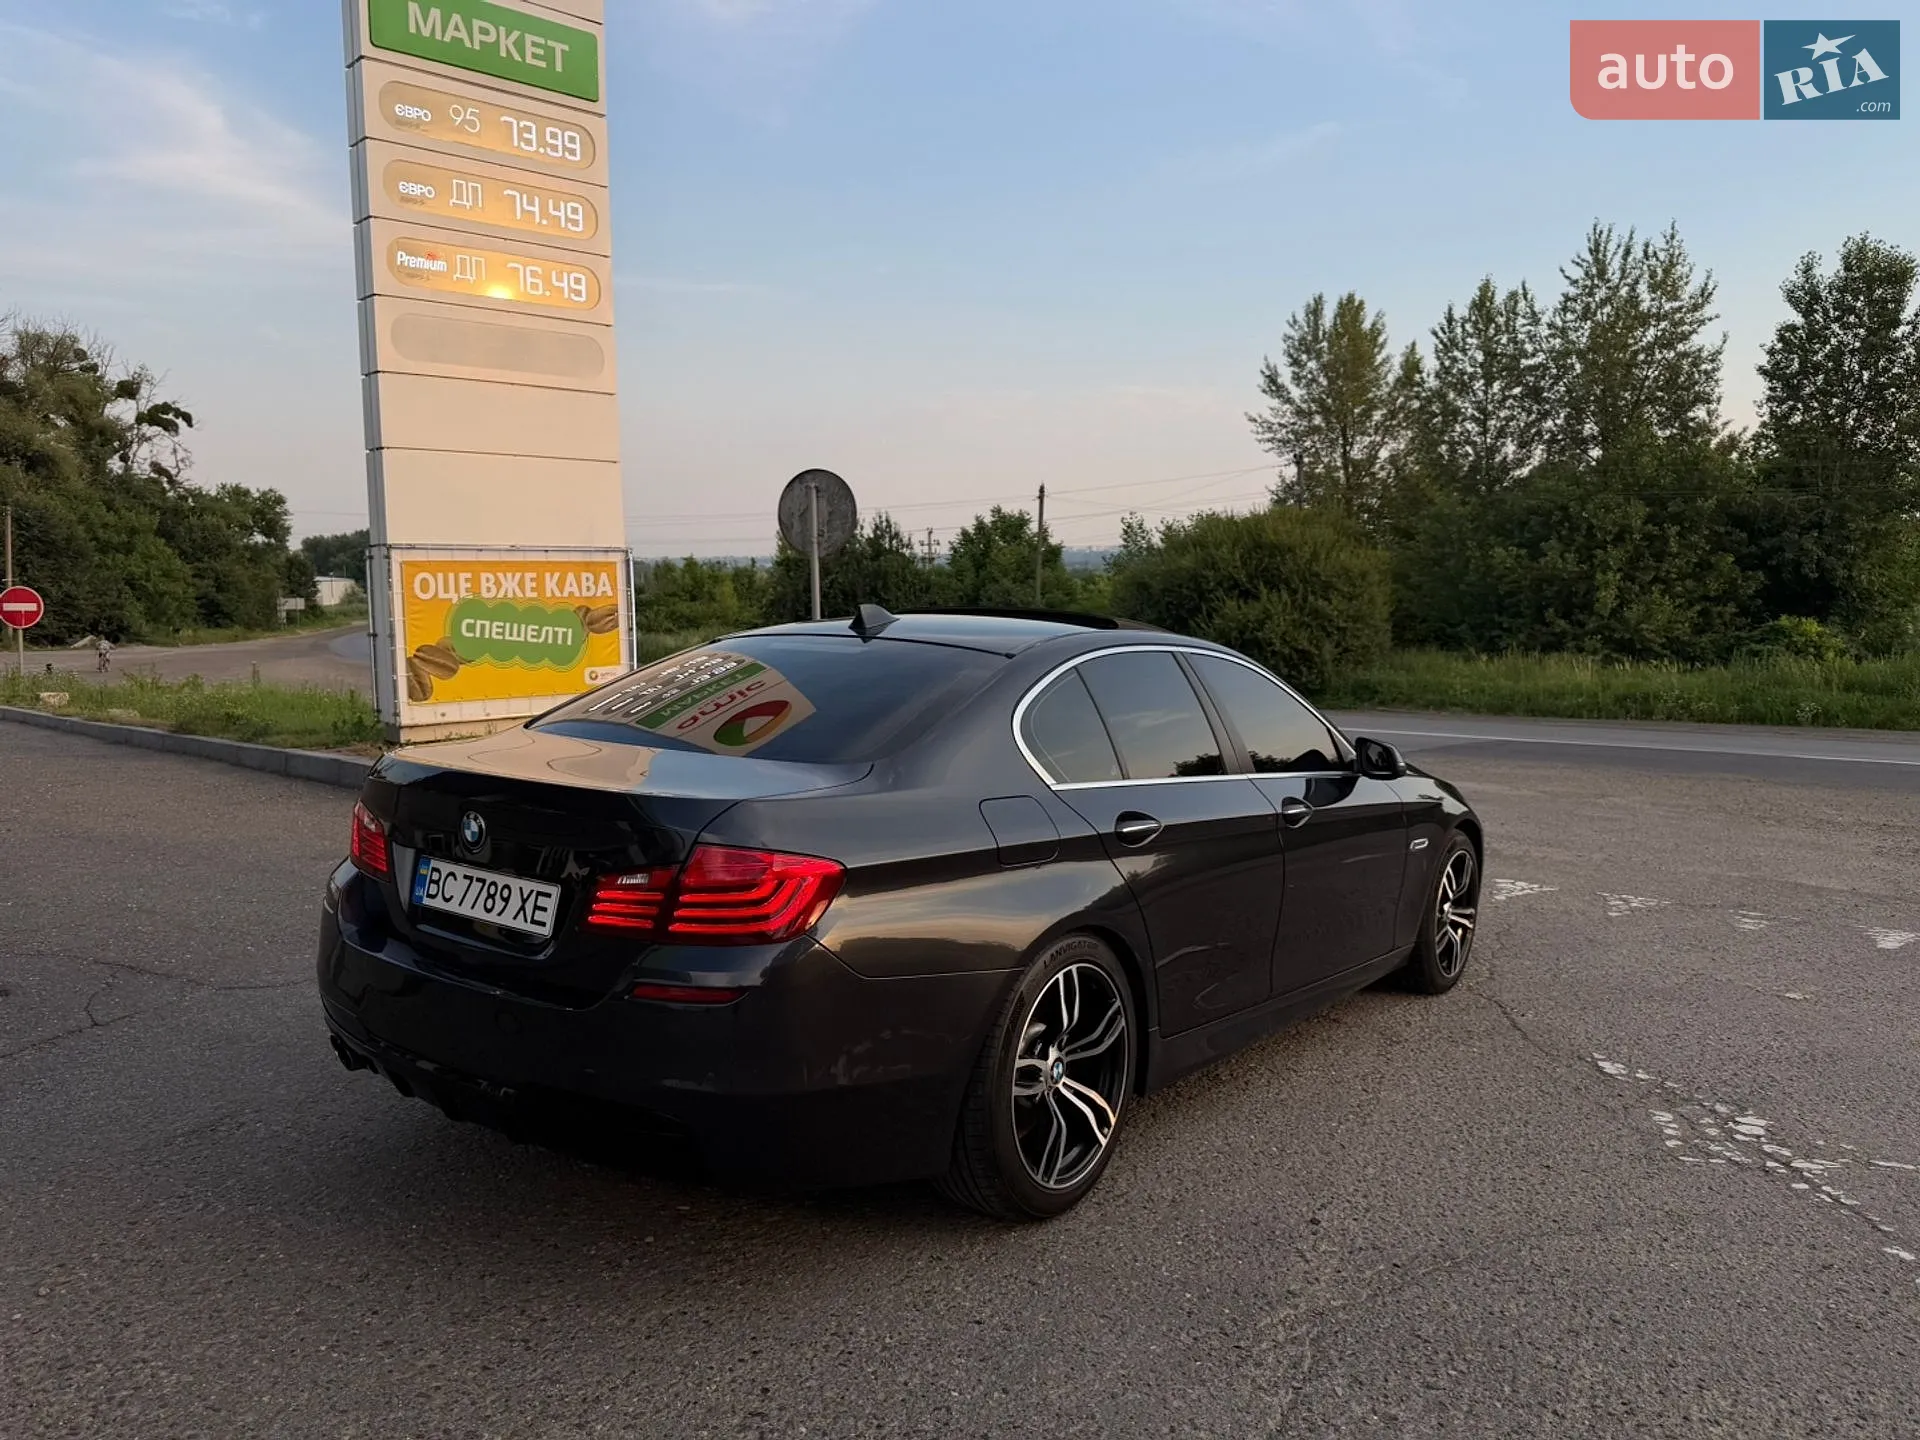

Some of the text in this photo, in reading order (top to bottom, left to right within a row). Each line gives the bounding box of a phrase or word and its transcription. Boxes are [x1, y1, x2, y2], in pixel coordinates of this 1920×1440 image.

[407, 1, 570, 72] МАРКЕТ
[395, 102, 581, 162] ЄВРО 95 73.99
[398, 178, 584, 233] ЄВРО ДП 74.49
[396, 250, 587, 303] Premium ДП 76.49
[413, 571, 613, 603] ОЦЕ ВЖЕ КАВА
[460, 618, 573, 646] СПЕШЕЛТІ
[426, 866, 552, 927] BC 7789 XE
